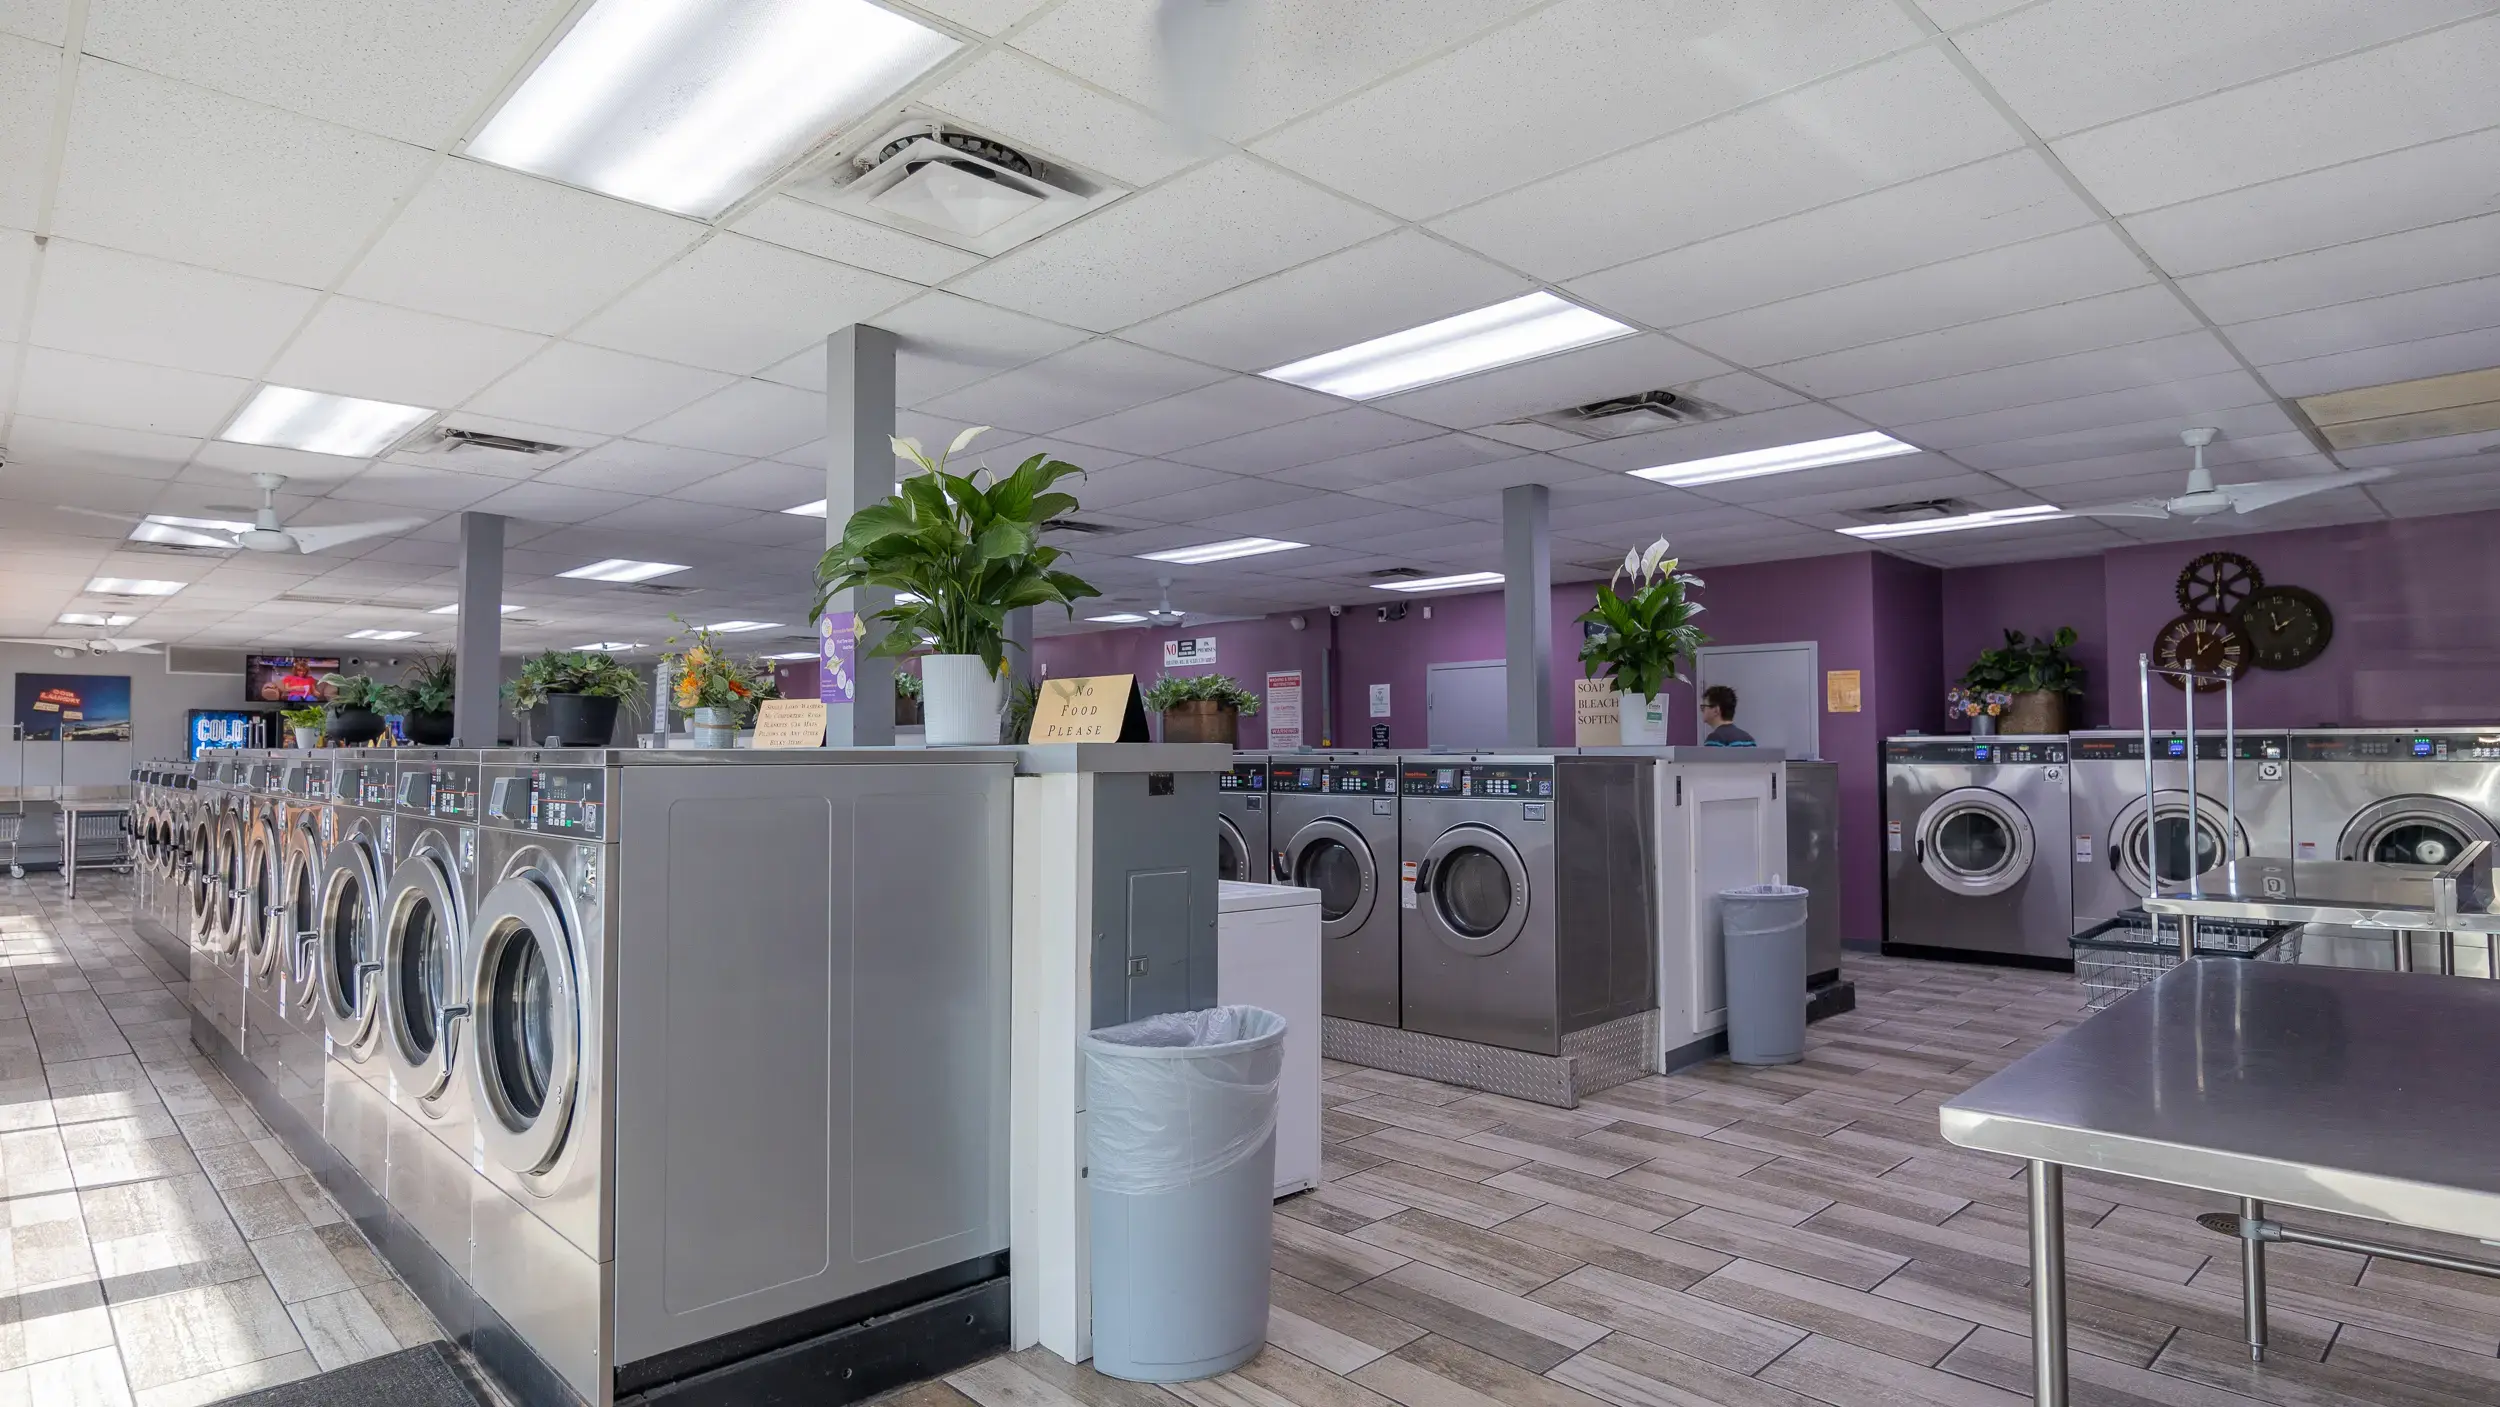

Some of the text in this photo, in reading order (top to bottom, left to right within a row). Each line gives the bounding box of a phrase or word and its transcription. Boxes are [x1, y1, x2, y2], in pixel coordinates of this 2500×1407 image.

[1166, 643, 1177, 656] NO
[1075, 685, 1094, 697] NO
[1577, 683, 1605, 693] SOAP
[1578, 698, 1619, 708] BLEACH
[1061, 704, 1098, 717] FOOD
[197, 719, 244, 742] COLD
[1047, 725, 1102, 737] PLEASE
[1387, 781, 1394, 789] 21
[1541, 784, 1550, 792] 22
